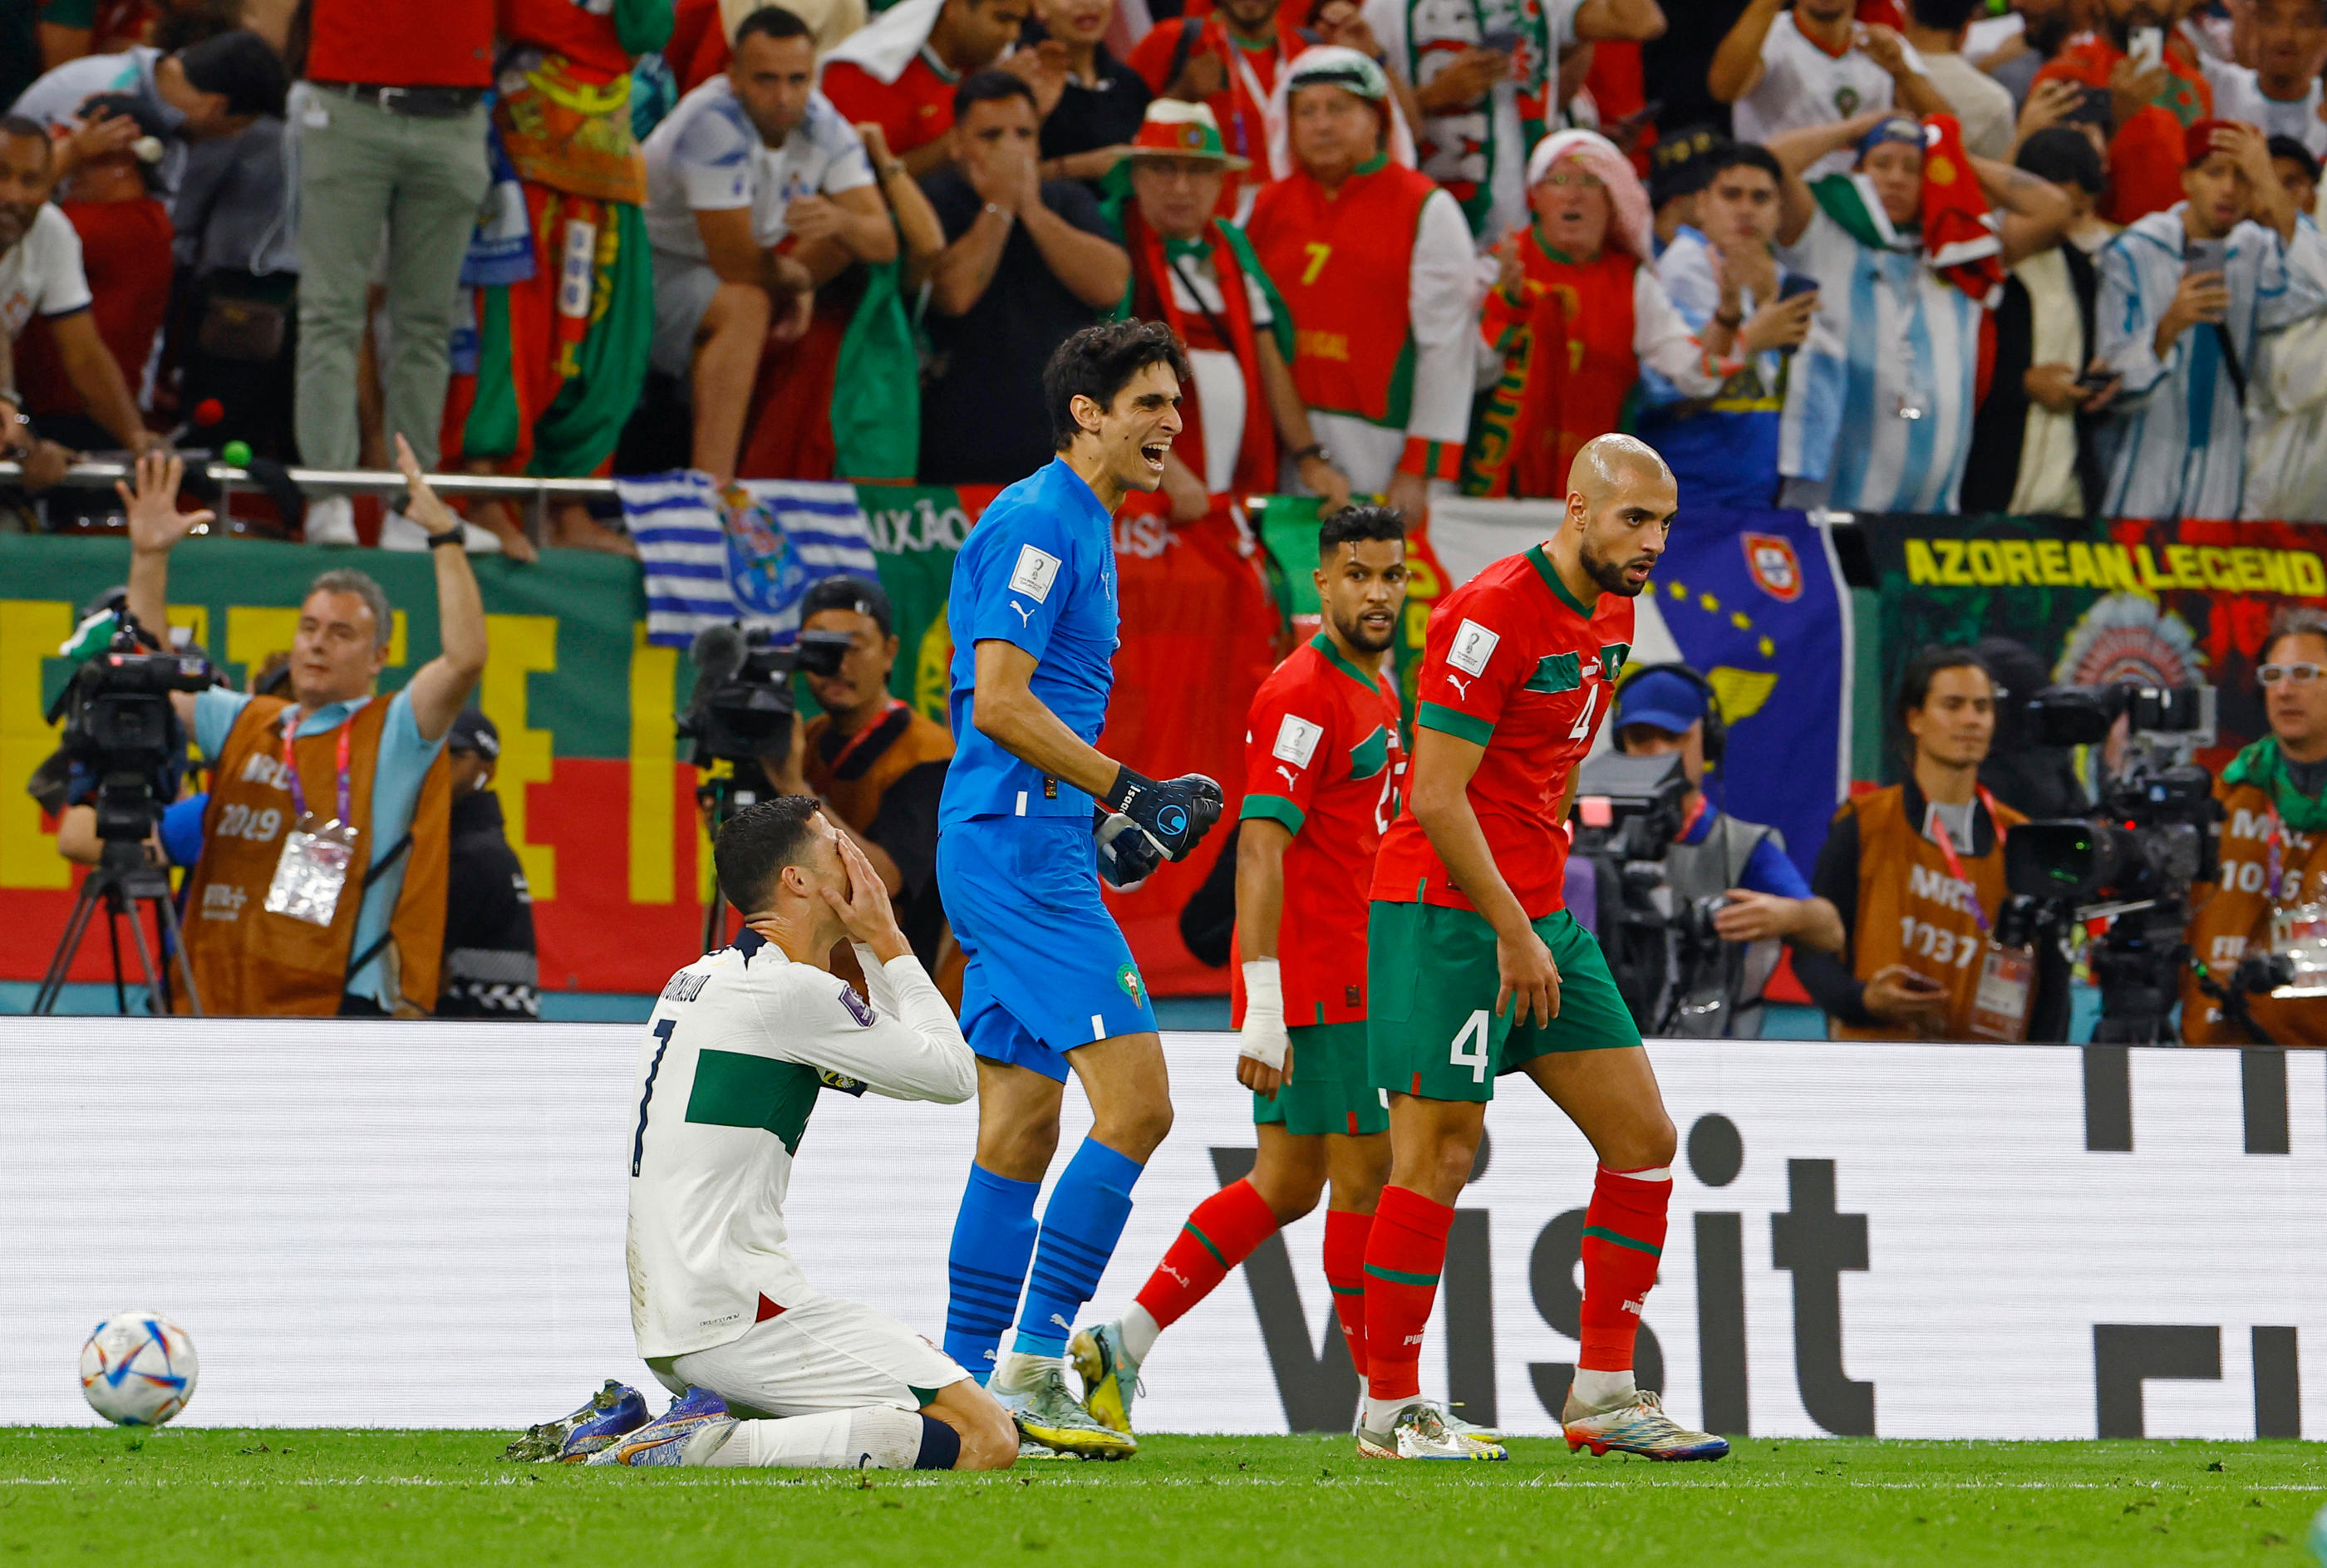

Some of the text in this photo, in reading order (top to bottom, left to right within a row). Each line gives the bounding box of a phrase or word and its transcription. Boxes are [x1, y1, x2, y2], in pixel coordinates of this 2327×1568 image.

[1301, 242, 1331, 286] 7
[1905, 539, 2141, 592] AZOREAN
[1567, 684, 1599, 749] 4
[2222, 859, 2302, 901] 106
[1449, 1009, 1490, 1084] 4
[632, 1019, 677, 1177] 7
[1208, 1112, 1877, 1436] visit
